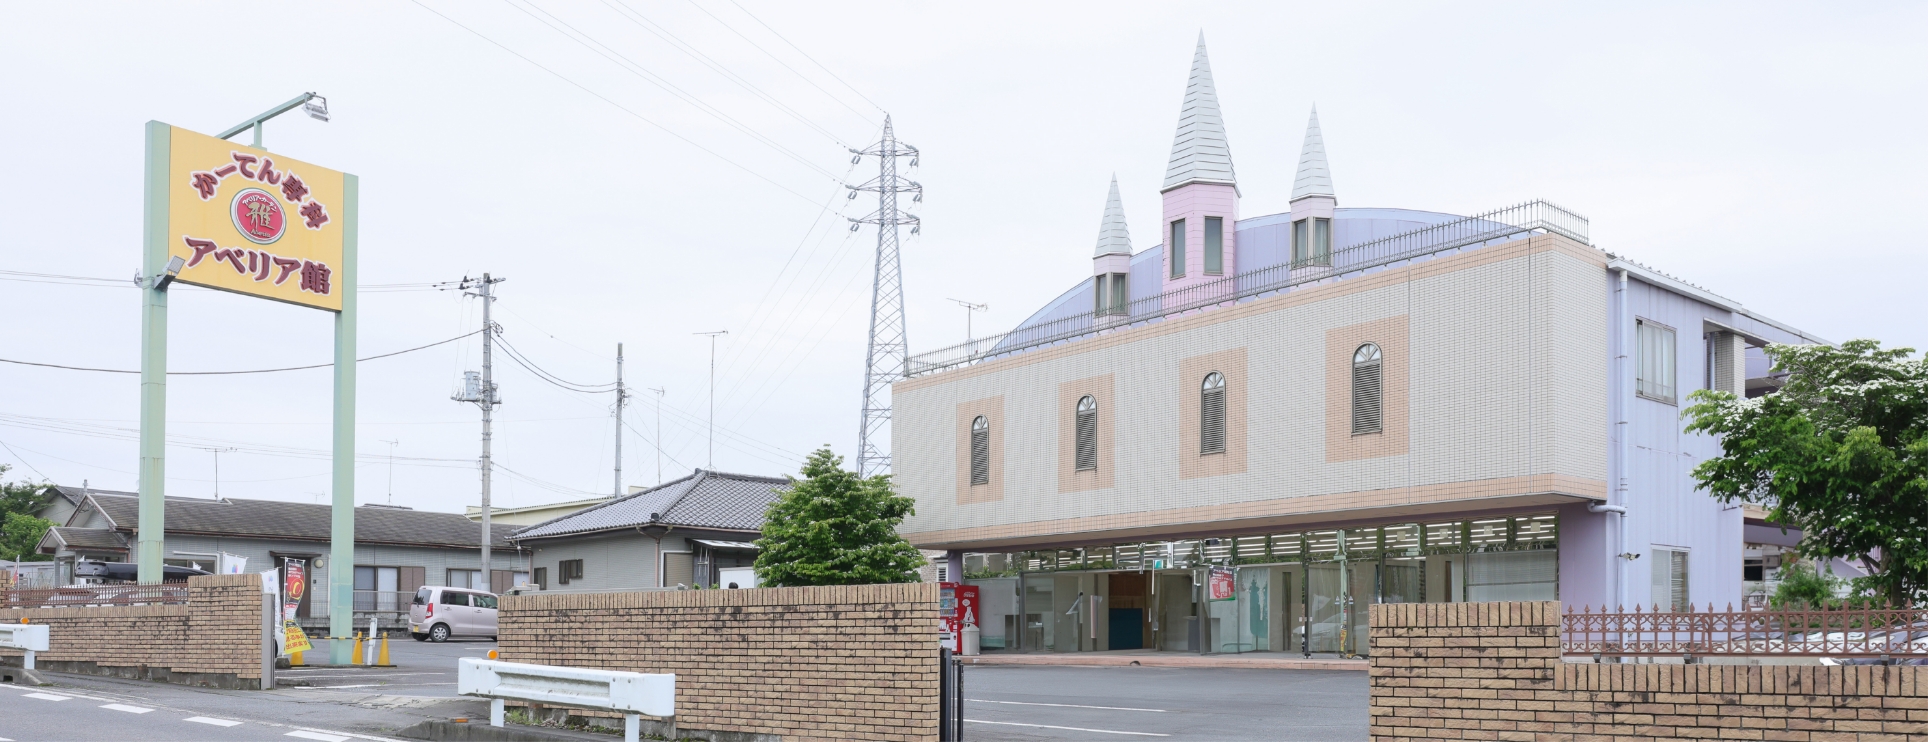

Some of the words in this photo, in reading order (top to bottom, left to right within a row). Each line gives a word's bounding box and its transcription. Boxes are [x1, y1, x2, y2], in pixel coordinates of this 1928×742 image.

[191, 151, 330, 230] かーてん専科
[245, 202, 275, 231] 雅
[183, 235, 333, 295] アベリア館
